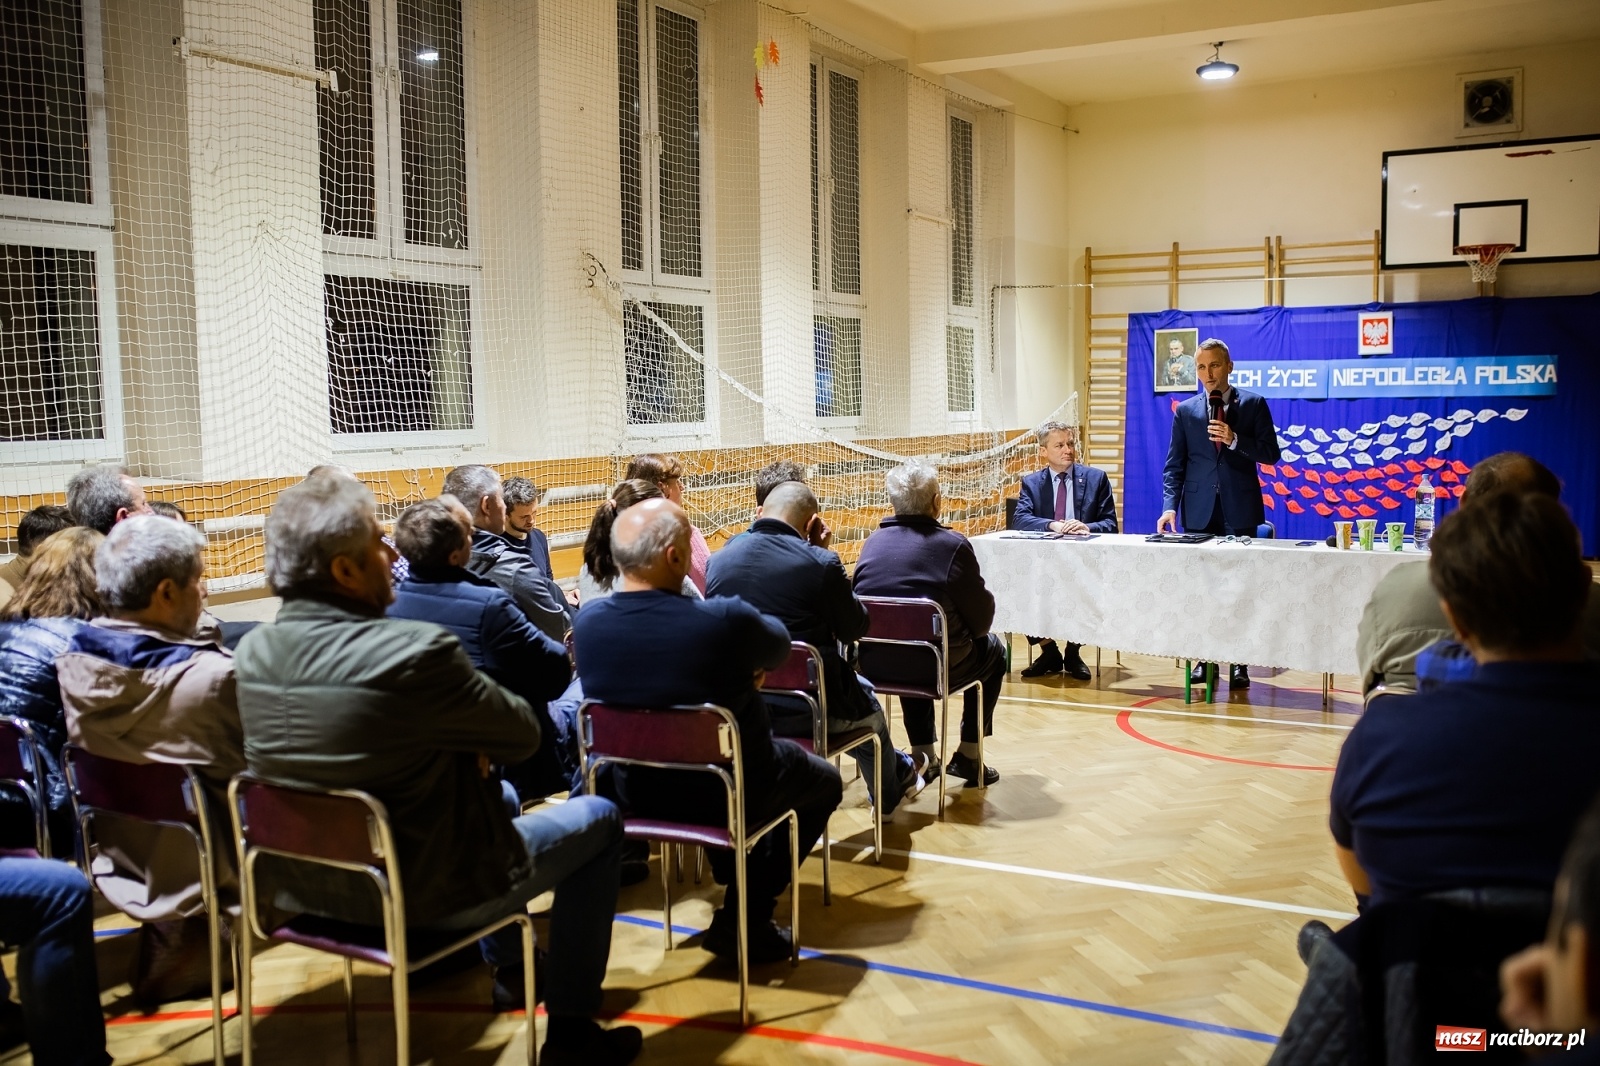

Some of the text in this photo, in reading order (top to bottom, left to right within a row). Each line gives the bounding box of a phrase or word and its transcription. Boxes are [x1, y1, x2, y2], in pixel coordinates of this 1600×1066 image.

[1228, 364, 1558, 388] ECH ŻYJE NIEPODLEGŁA POLSKA
